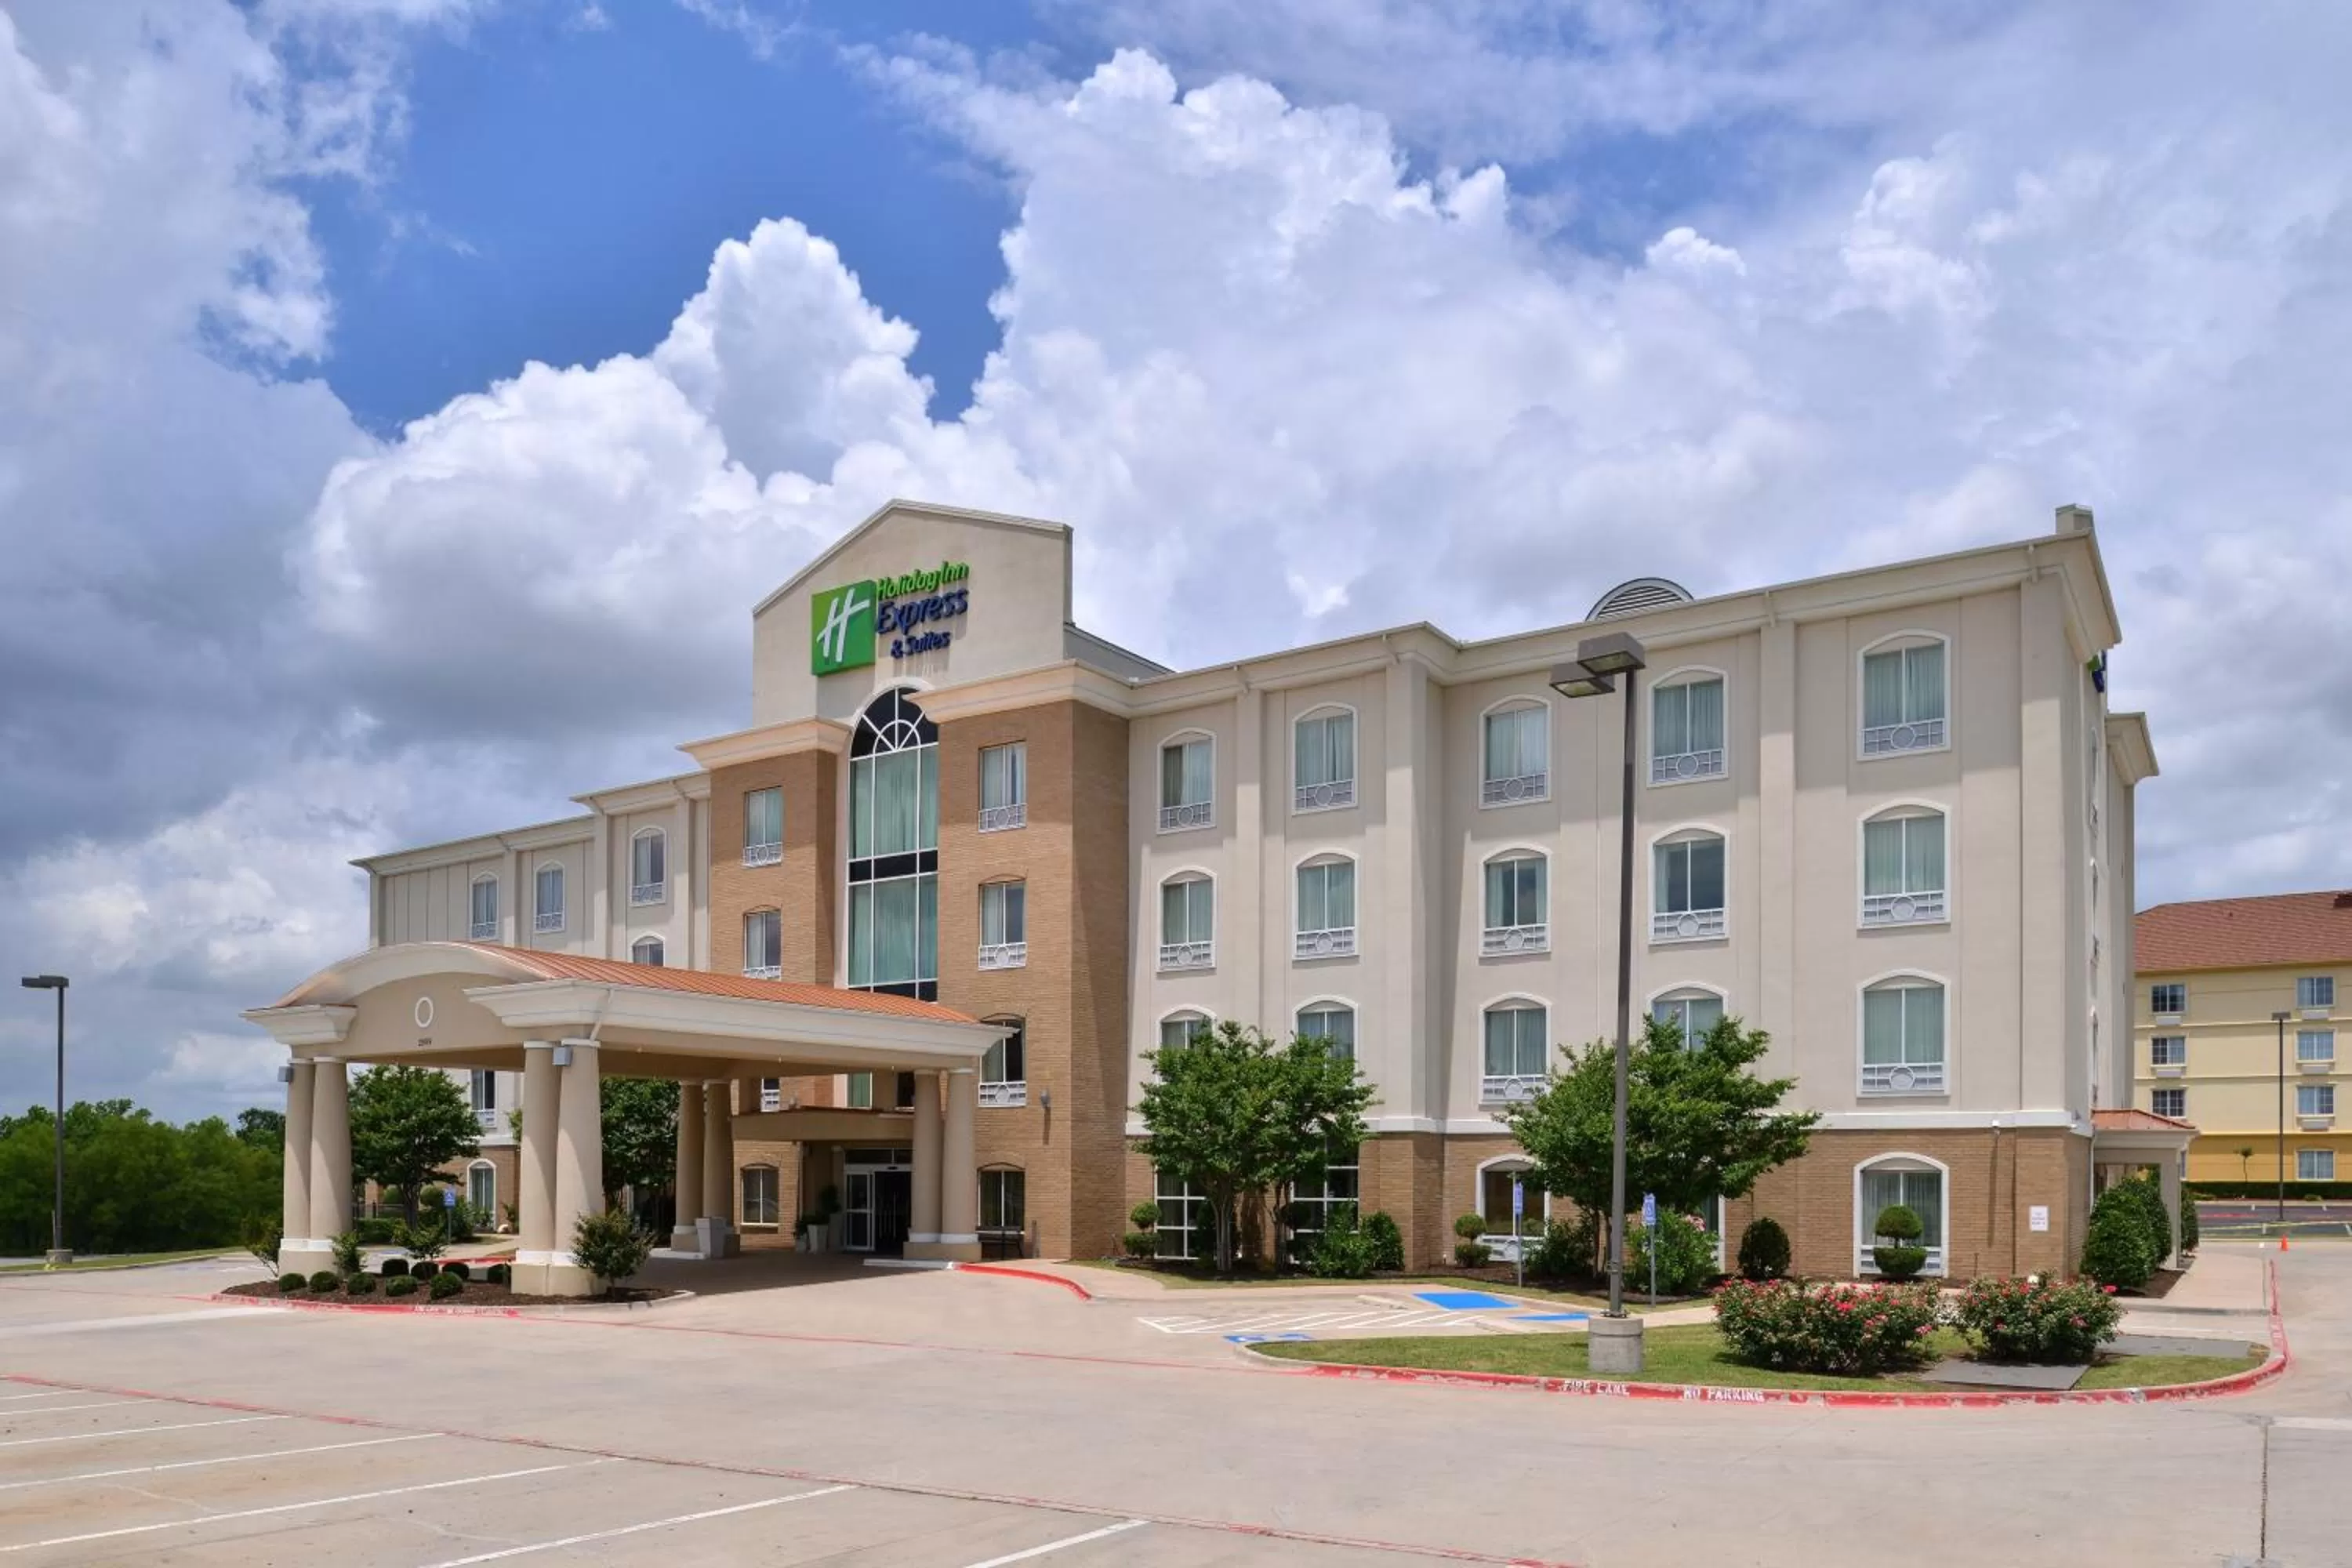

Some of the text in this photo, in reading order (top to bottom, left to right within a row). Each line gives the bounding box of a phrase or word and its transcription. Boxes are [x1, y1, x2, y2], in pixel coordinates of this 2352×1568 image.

[877, 561, 969, 601] Holiday Inn
[875, 588, 969, 635] Express
[891, 631, 951, 659] & Suites
